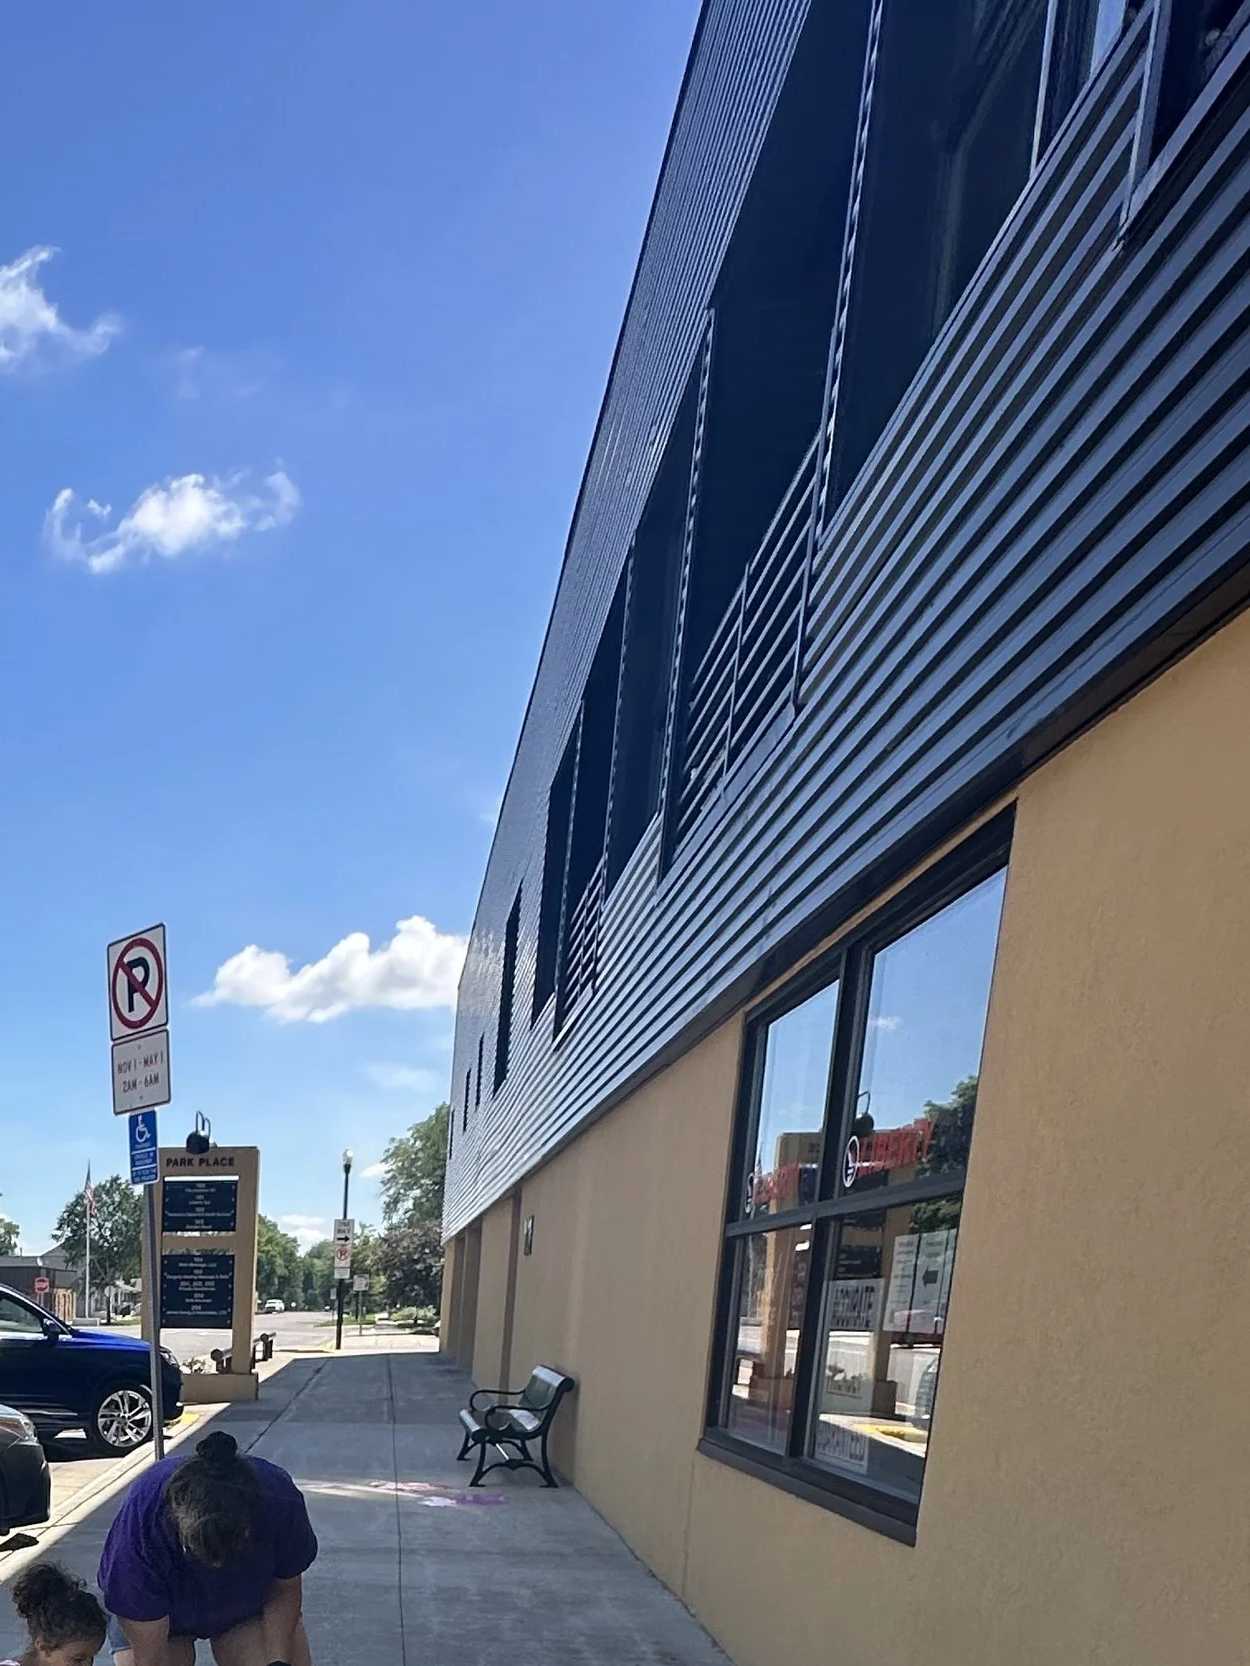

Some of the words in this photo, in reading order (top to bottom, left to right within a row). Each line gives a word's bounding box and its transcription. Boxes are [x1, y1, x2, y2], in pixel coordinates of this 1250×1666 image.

[117, 1060, 132, 1074] NOV
[143, 1052, 158, 1068] MAY
[122, 1079, 138, 1093] 2AM
[144, 1072, 160, 1088] 6AM
[166, 1157, 194, 1168] PARK
[199, 1157, 235, 1167] PLACE
